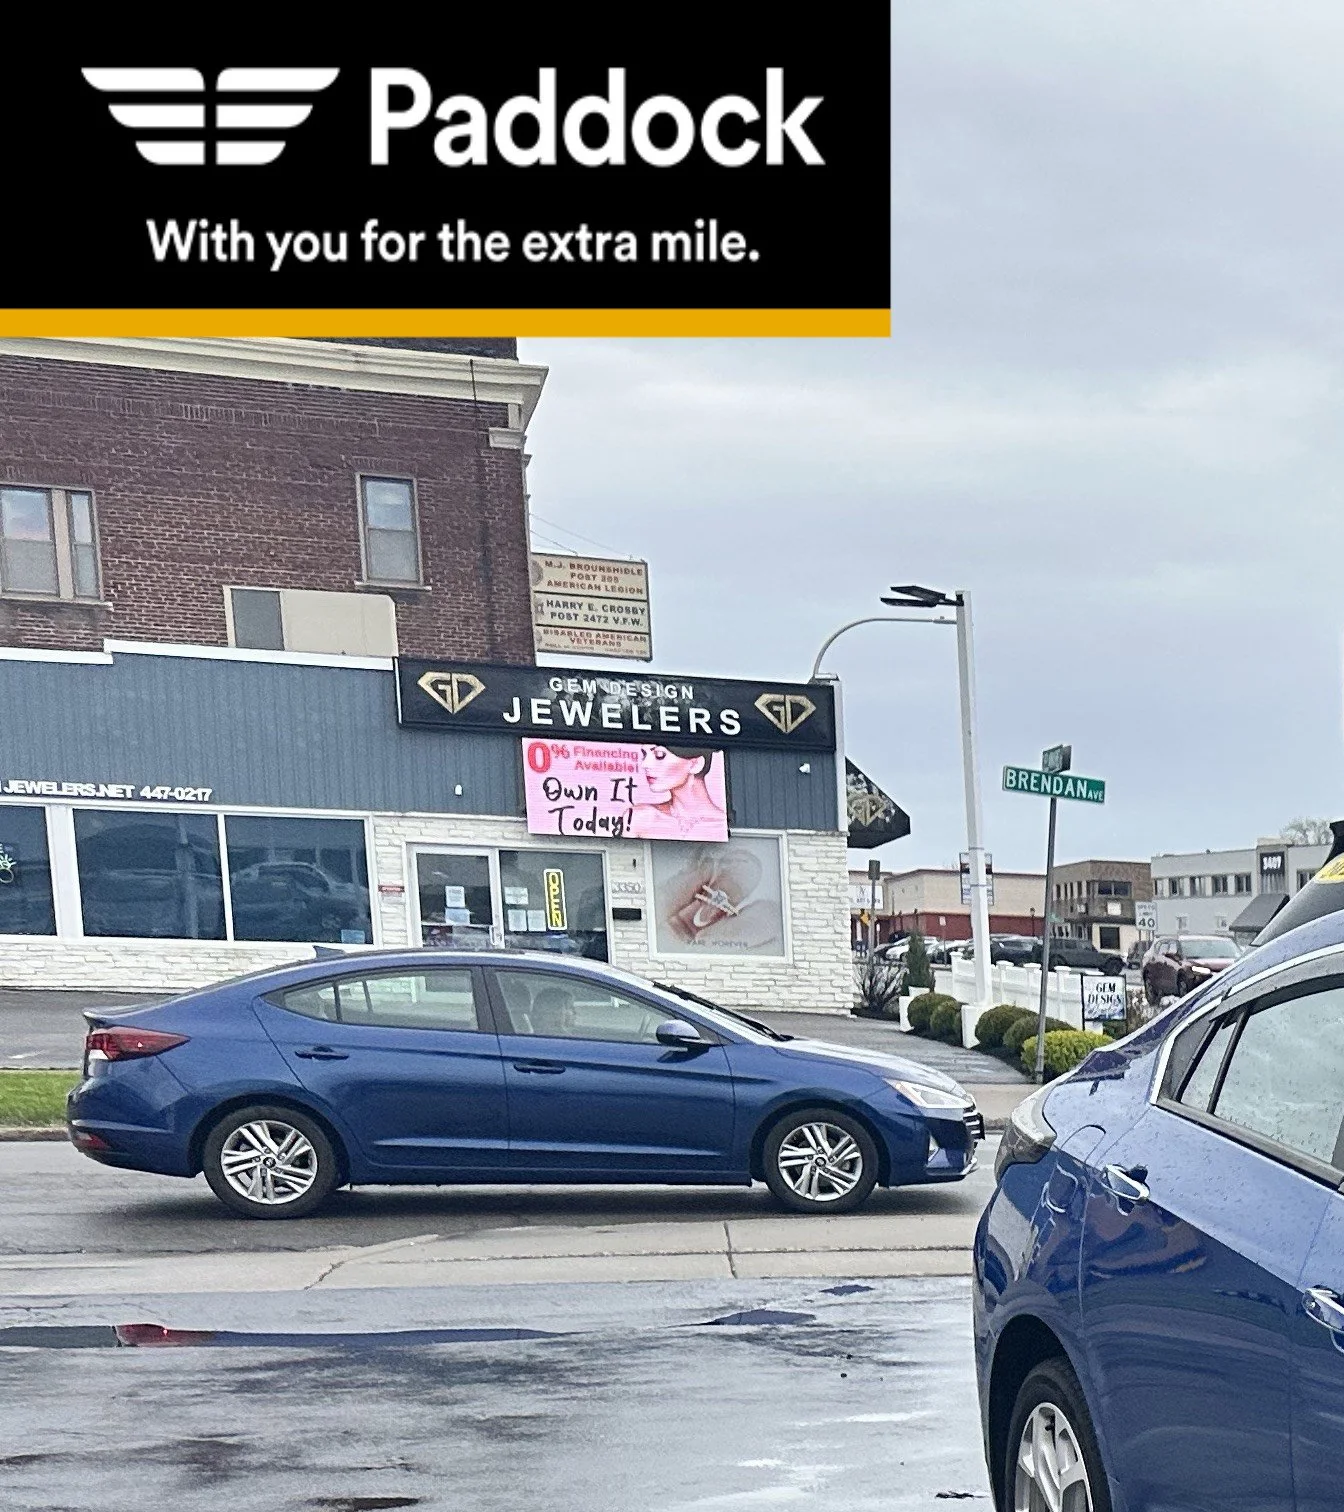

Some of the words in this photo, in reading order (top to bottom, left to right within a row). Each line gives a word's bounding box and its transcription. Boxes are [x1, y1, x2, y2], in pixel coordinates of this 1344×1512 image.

[570, 572, 597, 581] POST
[547, 580, 602, 591] AMERICAN
[605, 585, 643, 595] LEGION
[546, 600, 584, 610] HARRY
[602, 604, 646, 615] CROSBY
[550, 611, 579, 621] POST
[583, 614, 609, 624] 2472
[543, 629, 593, 639] DISABLED
[596, 633, 647, 643] AMERICAN
[570, 637, 622, 648] VETERANS
[549, 677, 598, 694] GEM
[609, 680, 695, 700] DESIGN
[502, 697, 742, 736] JEWELERS
[573, 745, 639, 761] Financing
[574, 760, 639, 773] Available!
[543, 777, 598, 801] Own
[610, 777, 638, 806] It
[1005, 768, 1087, 799] BRENDAN
[1087, 790, 1104, 801] AVE
[139, 785, 212, 802] 447-0217
[548, 806, 633, 838] Today!
[548, 872, 562, 928] OPEN
[1138, 917, 1155, 927] 40
[1095, 982, 1116, 993] GEM
